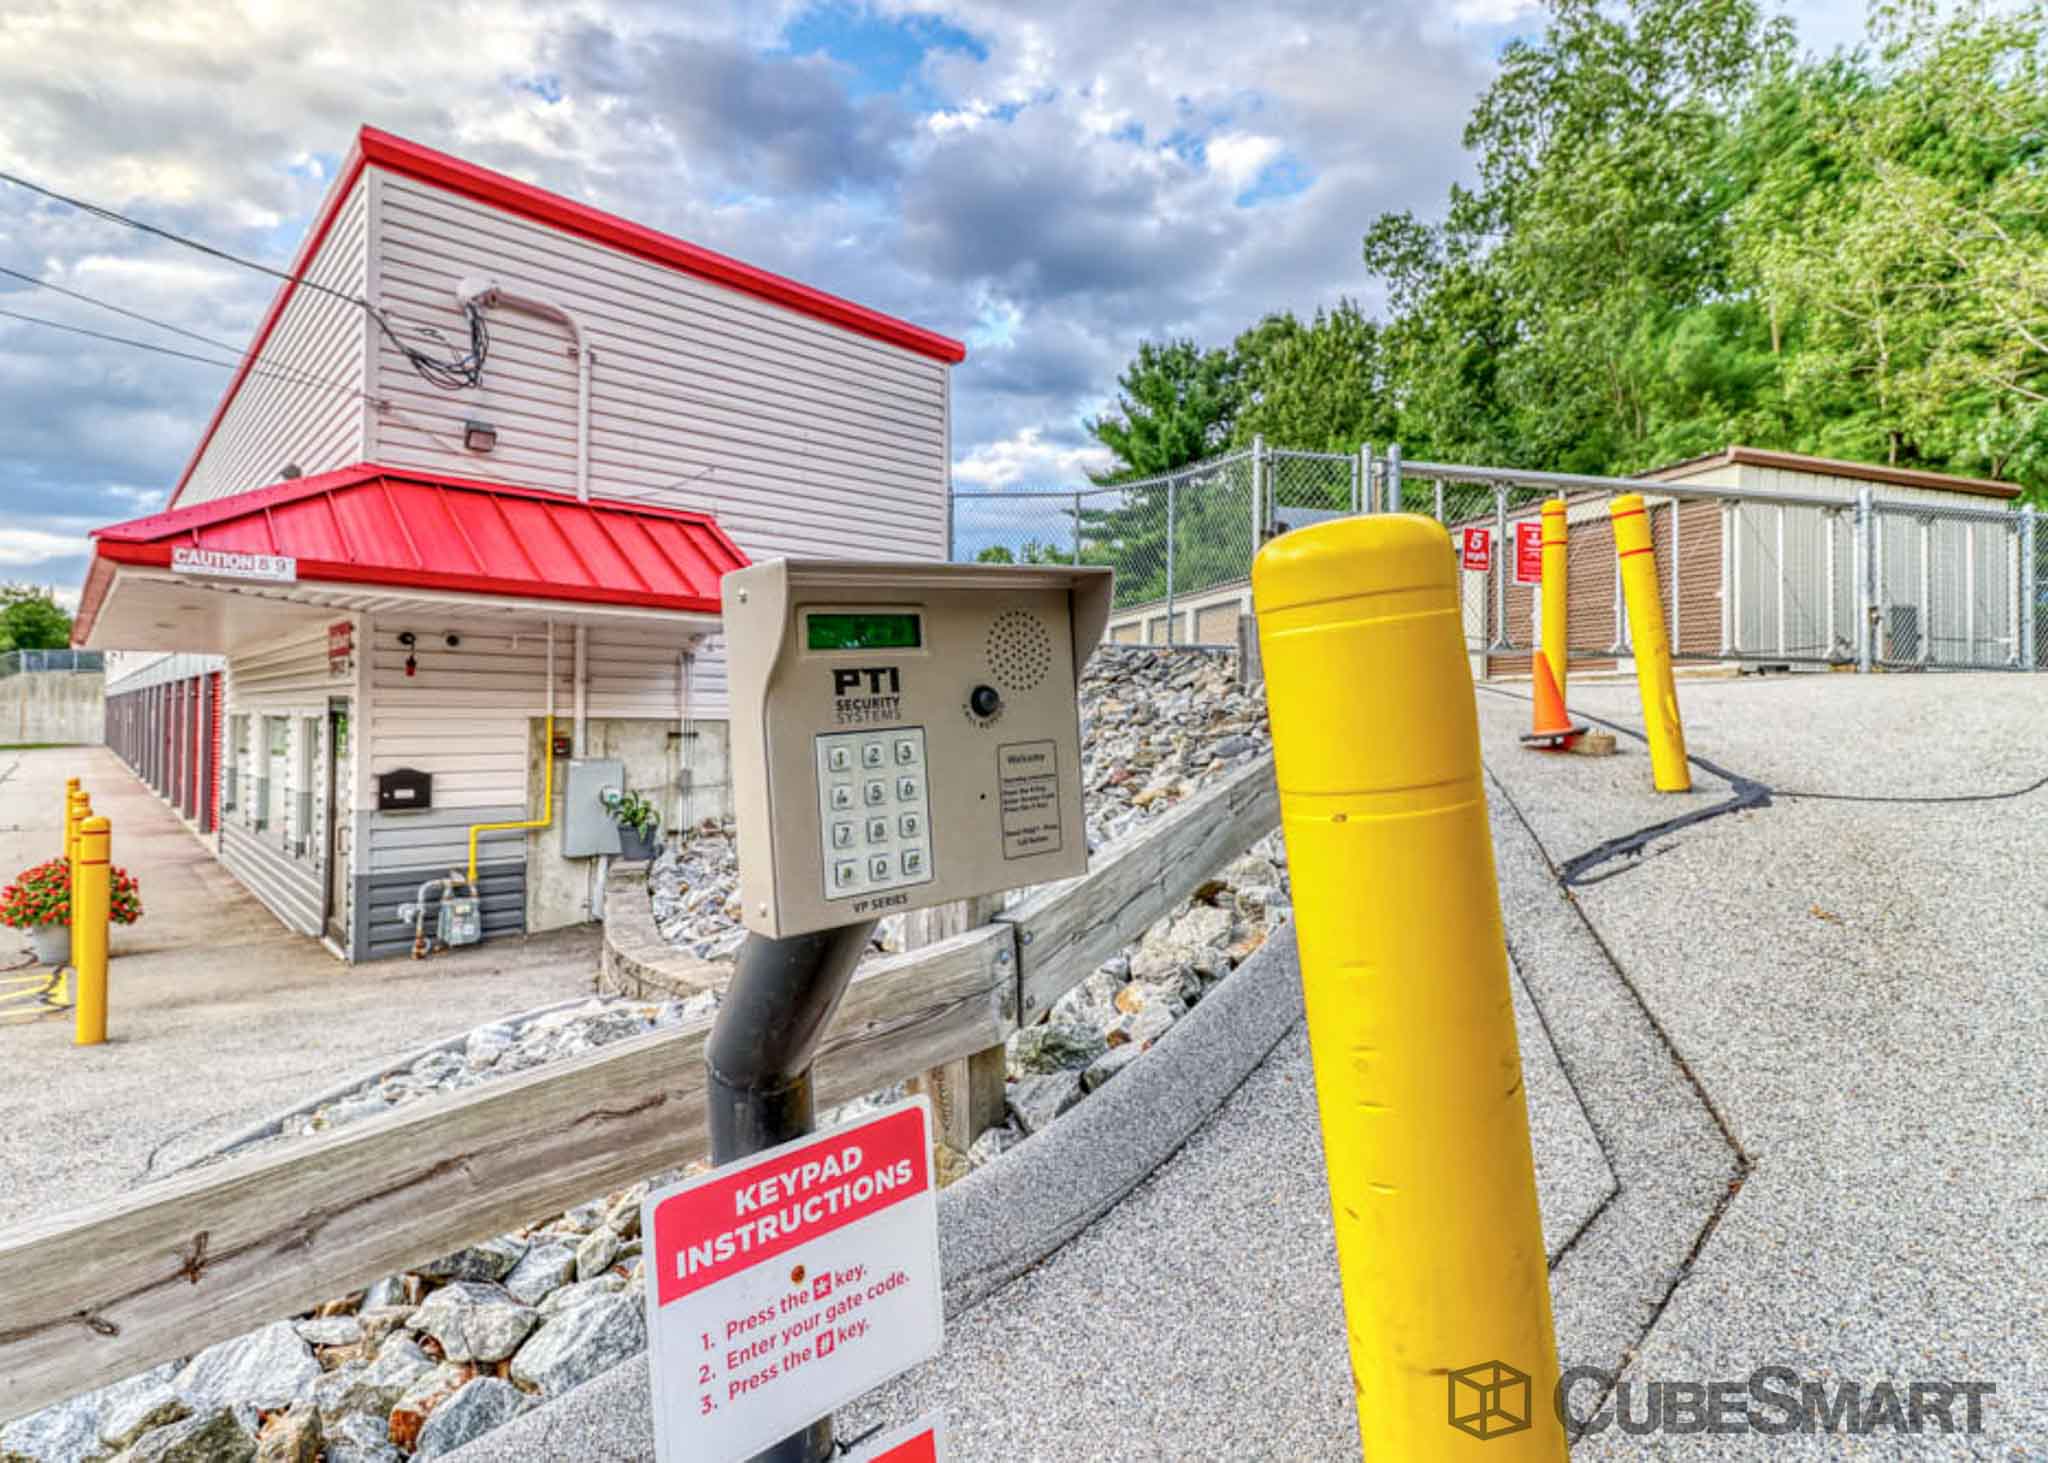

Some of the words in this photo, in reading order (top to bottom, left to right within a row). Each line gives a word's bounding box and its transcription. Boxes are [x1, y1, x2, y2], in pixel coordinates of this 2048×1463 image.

[1470, 531, 1484, 550] 5
[175, 549, 255, 570] CAUTION
[832, 666, 899, 696] PTI
[836, 696, 900, 711] SECURITY
[837, 708, 902, 724] SYSTEMS
[869, 748, 879, 763] 2
[902, 745, 912, 760] 3
[837, 788, 848, 804] 4
[872, 785, 882, 801] 5
[904, 781, 914, 796] 6
[840, 827, 850, 844] 7
[874, 822, 885, 838] 8
[906, 818, 916, 833] 9
[877, 860, 887, 875] 0
[853, 900, 869, 914] VP
[872, 893, 908, 911] SERIES
[735, 1146, 863, 1216] KEYPAD
[676, 1160, 912, 1279] INSTRUCTIONS
[700, 1333, 715, 1350] 1.
[726, 1305, 776, 1340] Press
[780, 1288, 808, 1315] the
[835, 1264, 867, 1289] key.
[699, 1365, 716, 1384] 2.
[727, 1334, 777, 1371] Enter
[782, 1314, 820, 1347] your
[826, 1292, 862, 1324] gate
[867, 1271, 910, 1301] code.
[701, 1396, 718, 1415] 3.
[728, 1365, 778, 1401] Press
[783, 1346, 812, 1371] the
[837, 1319, 870, 1345] key.
